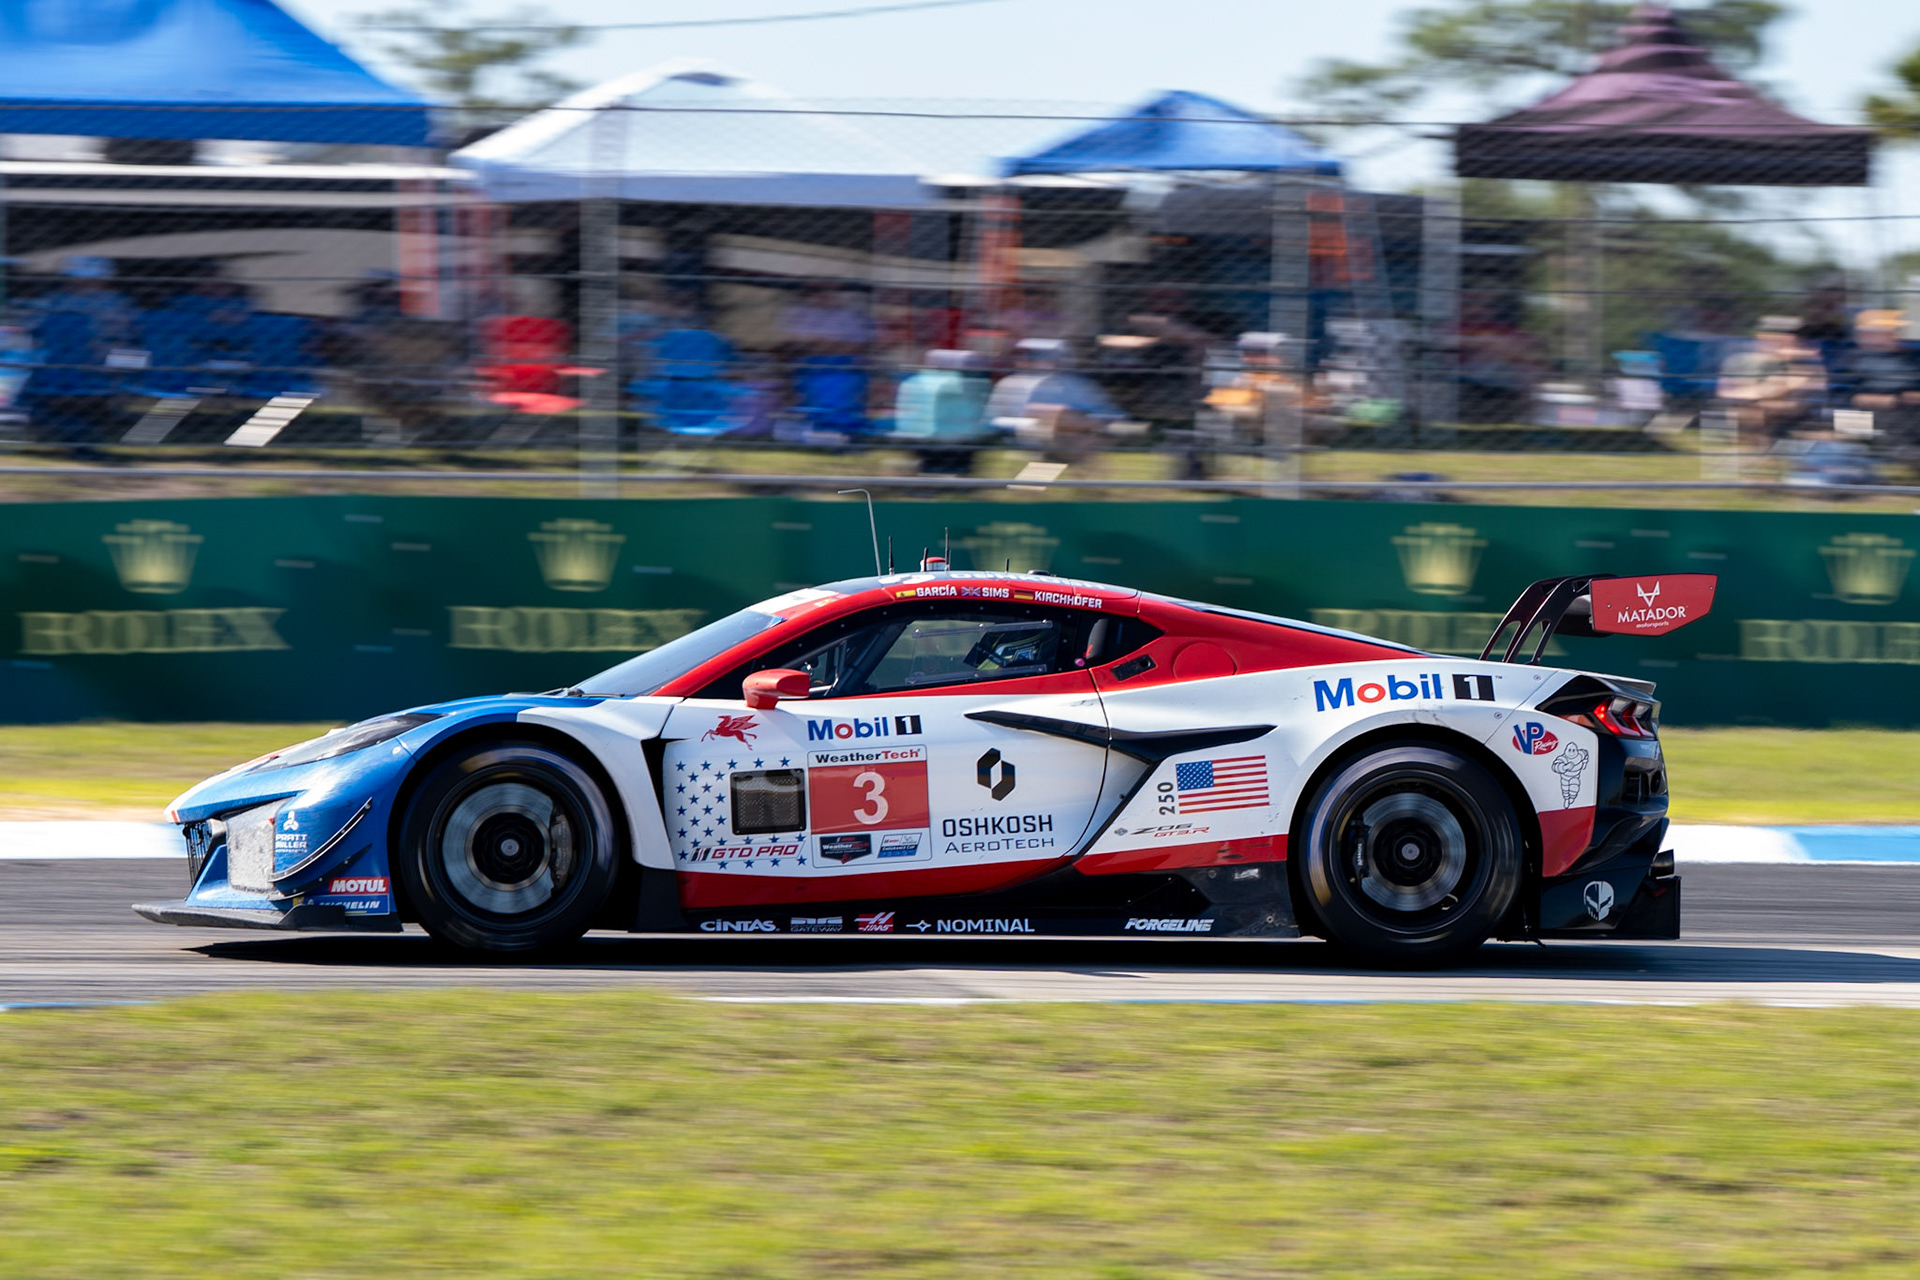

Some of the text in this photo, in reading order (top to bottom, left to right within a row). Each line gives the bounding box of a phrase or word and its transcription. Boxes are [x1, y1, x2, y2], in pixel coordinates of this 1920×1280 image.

[916, 584, 957, 597] GARCÍA
[981, 587, 1010, 599] SIMS
[1034, 591, 1103, 608] KIRCHHÖFER
[1617, 606, 1686, 623] MATADOR
[17, 607, 292, 654] ROLEX
[1313, 673, 1443, 712] Mobil
[807, 717, 889, 741] Mobil
[1513, 722, 1559, 755] VP Racing
[815, 748, 921, 763] WeatherTech
[853, 771, 889, 825] 3
[1157, 782, 1175, 815] 250
[942, 815, 1053, 837] OSHKOSH
[1130, 823, 1193, 835] Z06
[1154, 826, 1210, 838] GT3.R
[275, 841, 307, 849] MILLER
[711, 845, 799, 859] GTD PRO
[331, 879, 387, 892] MOTUL
[936, 919, 1036, 933] NOMINAL
[1124, 918, 1214, 932] FORGELINE
